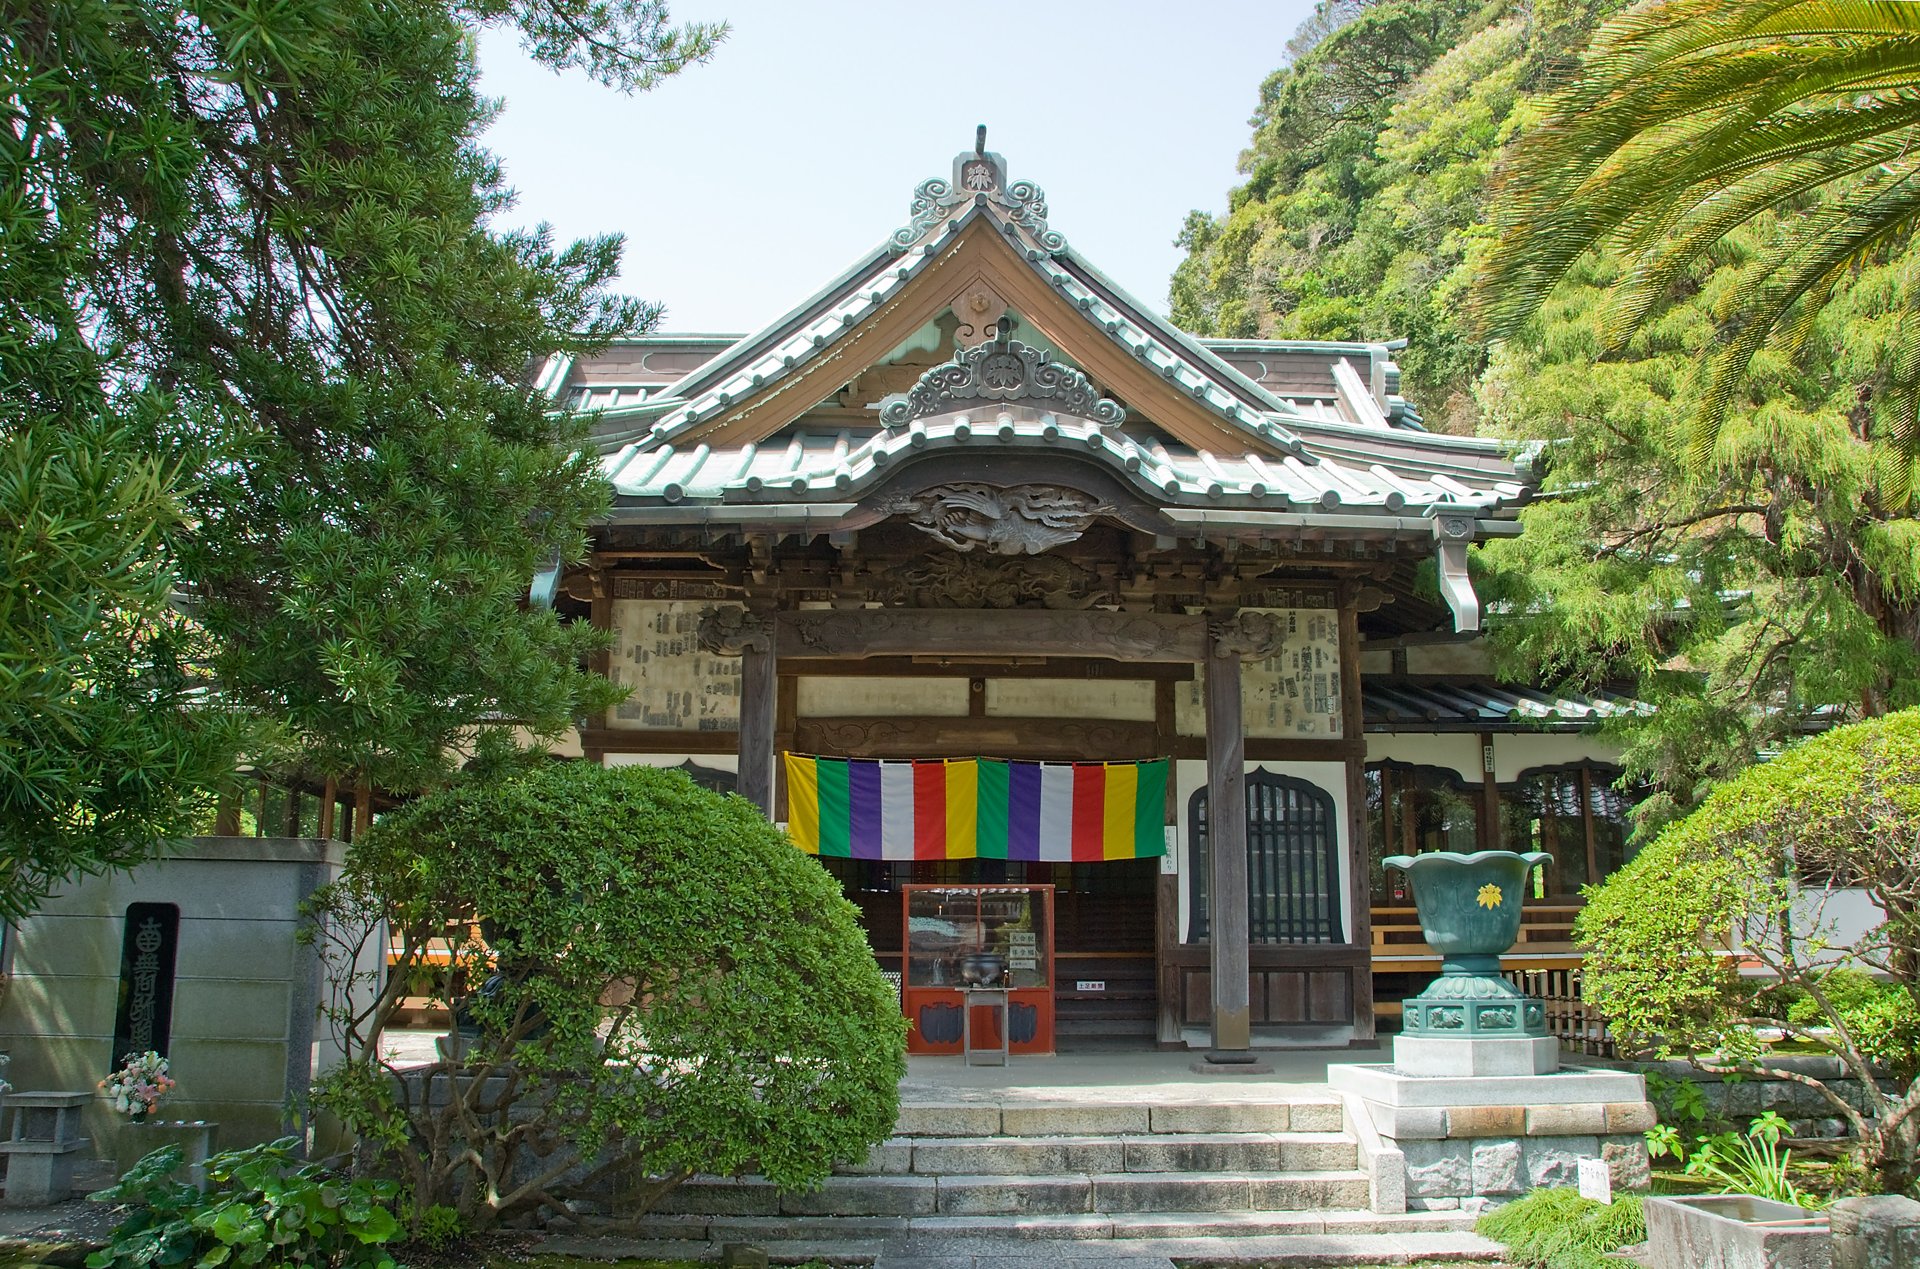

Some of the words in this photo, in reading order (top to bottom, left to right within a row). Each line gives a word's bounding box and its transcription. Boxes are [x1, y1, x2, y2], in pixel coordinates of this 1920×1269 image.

[129, 916, 162, 1056] 南無阿弥陀
